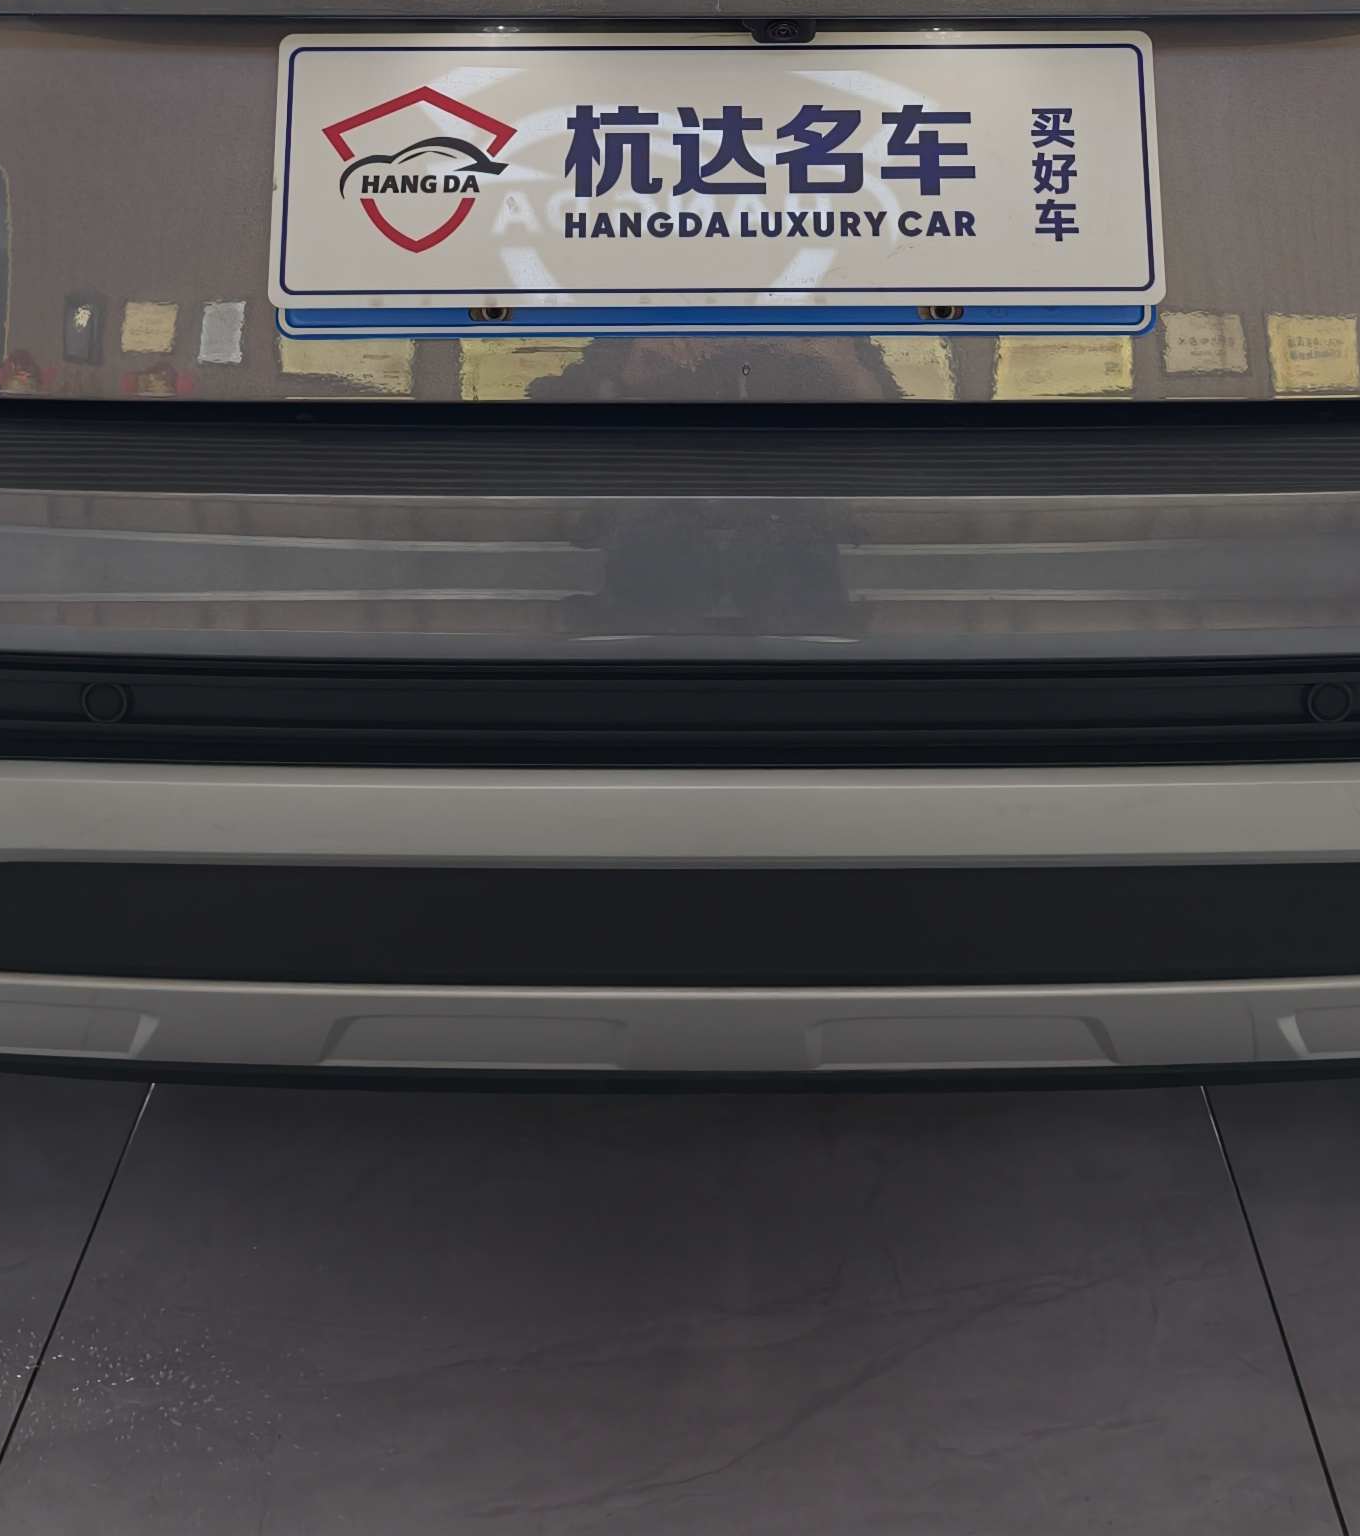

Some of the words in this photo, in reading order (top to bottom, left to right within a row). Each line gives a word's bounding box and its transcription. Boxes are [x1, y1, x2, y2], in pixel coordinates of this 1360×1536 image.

[564, 104, 977, 197] 杭达名车
[1029, 107, 1080, 243] 买好车
[361, 174, 437, 194] HANG
[443, 174, 480, 194] DA
[564, 210, 731, 239] HANGDA
[740, 209, 888, 238] LUXURY
[897, 209, 977, 238] CAR
